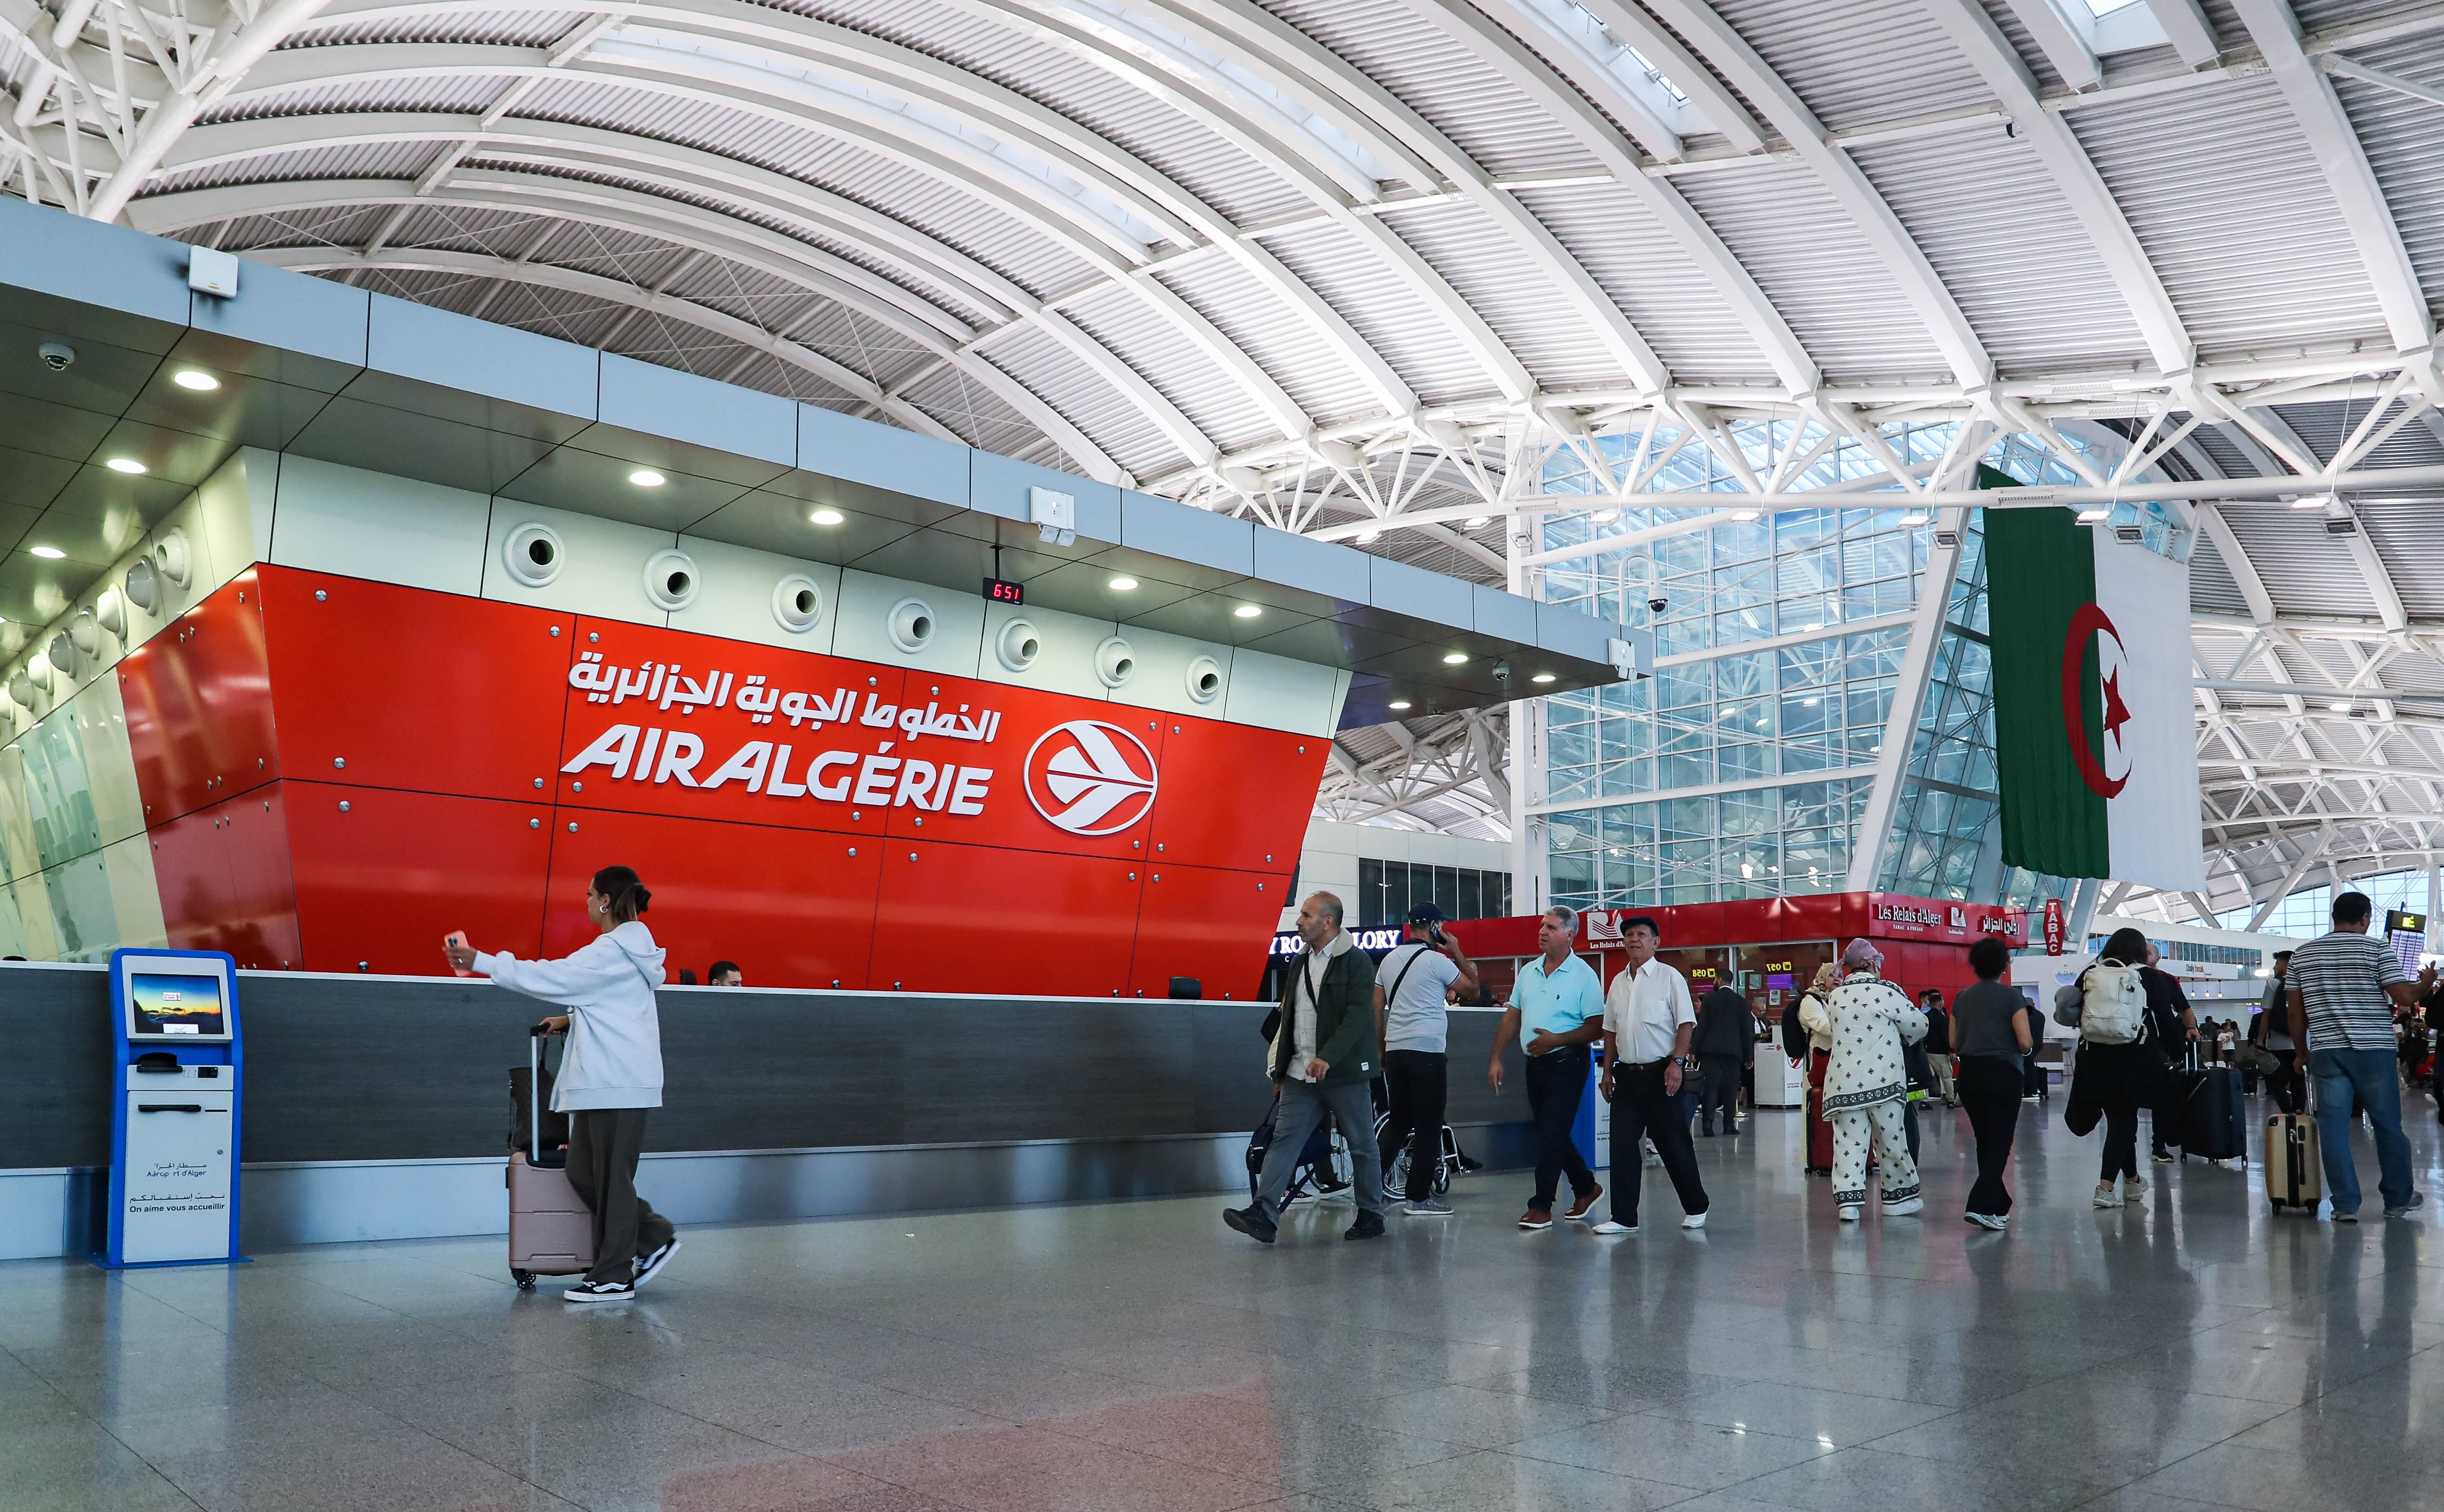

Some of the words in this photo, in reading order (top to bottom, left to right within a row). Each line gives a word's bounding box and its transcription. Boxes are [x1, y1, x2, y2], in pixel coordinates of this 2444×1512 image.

[994, 584, 1019, 599] 651
[568, 651, 734, 715] الجزائرية
[736, 676, 857, 730] الجوية
[860, 692, 1001, 743] الخطوط
[559, 724, 704, 788] AIR
[699, 741, 994, 816] ALGÉRIE
[1878, 904, 1891, 920] Les
[1893, 905, 1916, 923] Relais
[1917, 908, 1942, 927] d'Alger
[2048, 902, 2059, 952] TABAC
